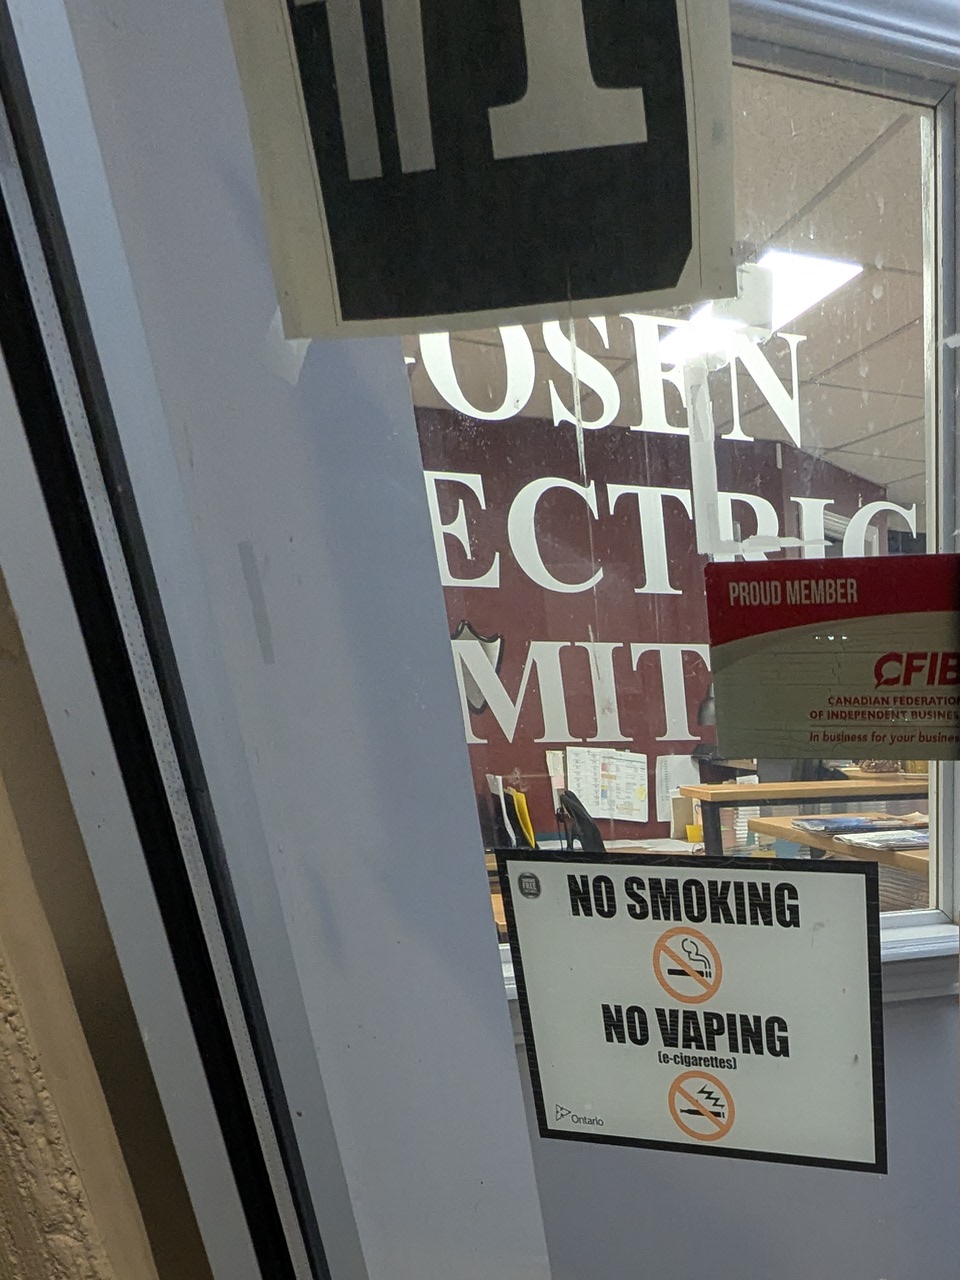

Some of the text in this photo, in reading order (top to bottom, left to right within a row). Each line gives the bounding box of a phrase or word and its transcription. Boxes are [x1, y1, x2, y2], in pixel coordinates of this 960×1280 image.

[404, 313, 807, 449] OSEN
[728, 578, 858, 606] PROUD MEMBER
[828, 696, 890, 707] CANADIAN
[810, 710, 824, 720] OF
[827, 710, 908, 721] INDEPENDENT
[809, 732, 820, 742] In
[823, 731, 868, 742] business
[871, 731, 887, 743] for
[889, 734, 915, 745] your
[566, 874, 801, 928] NO SMOKING
[600, 1003, 790, 1058] NO VAPING
[571, 1114, 605, 1126] Ontario
